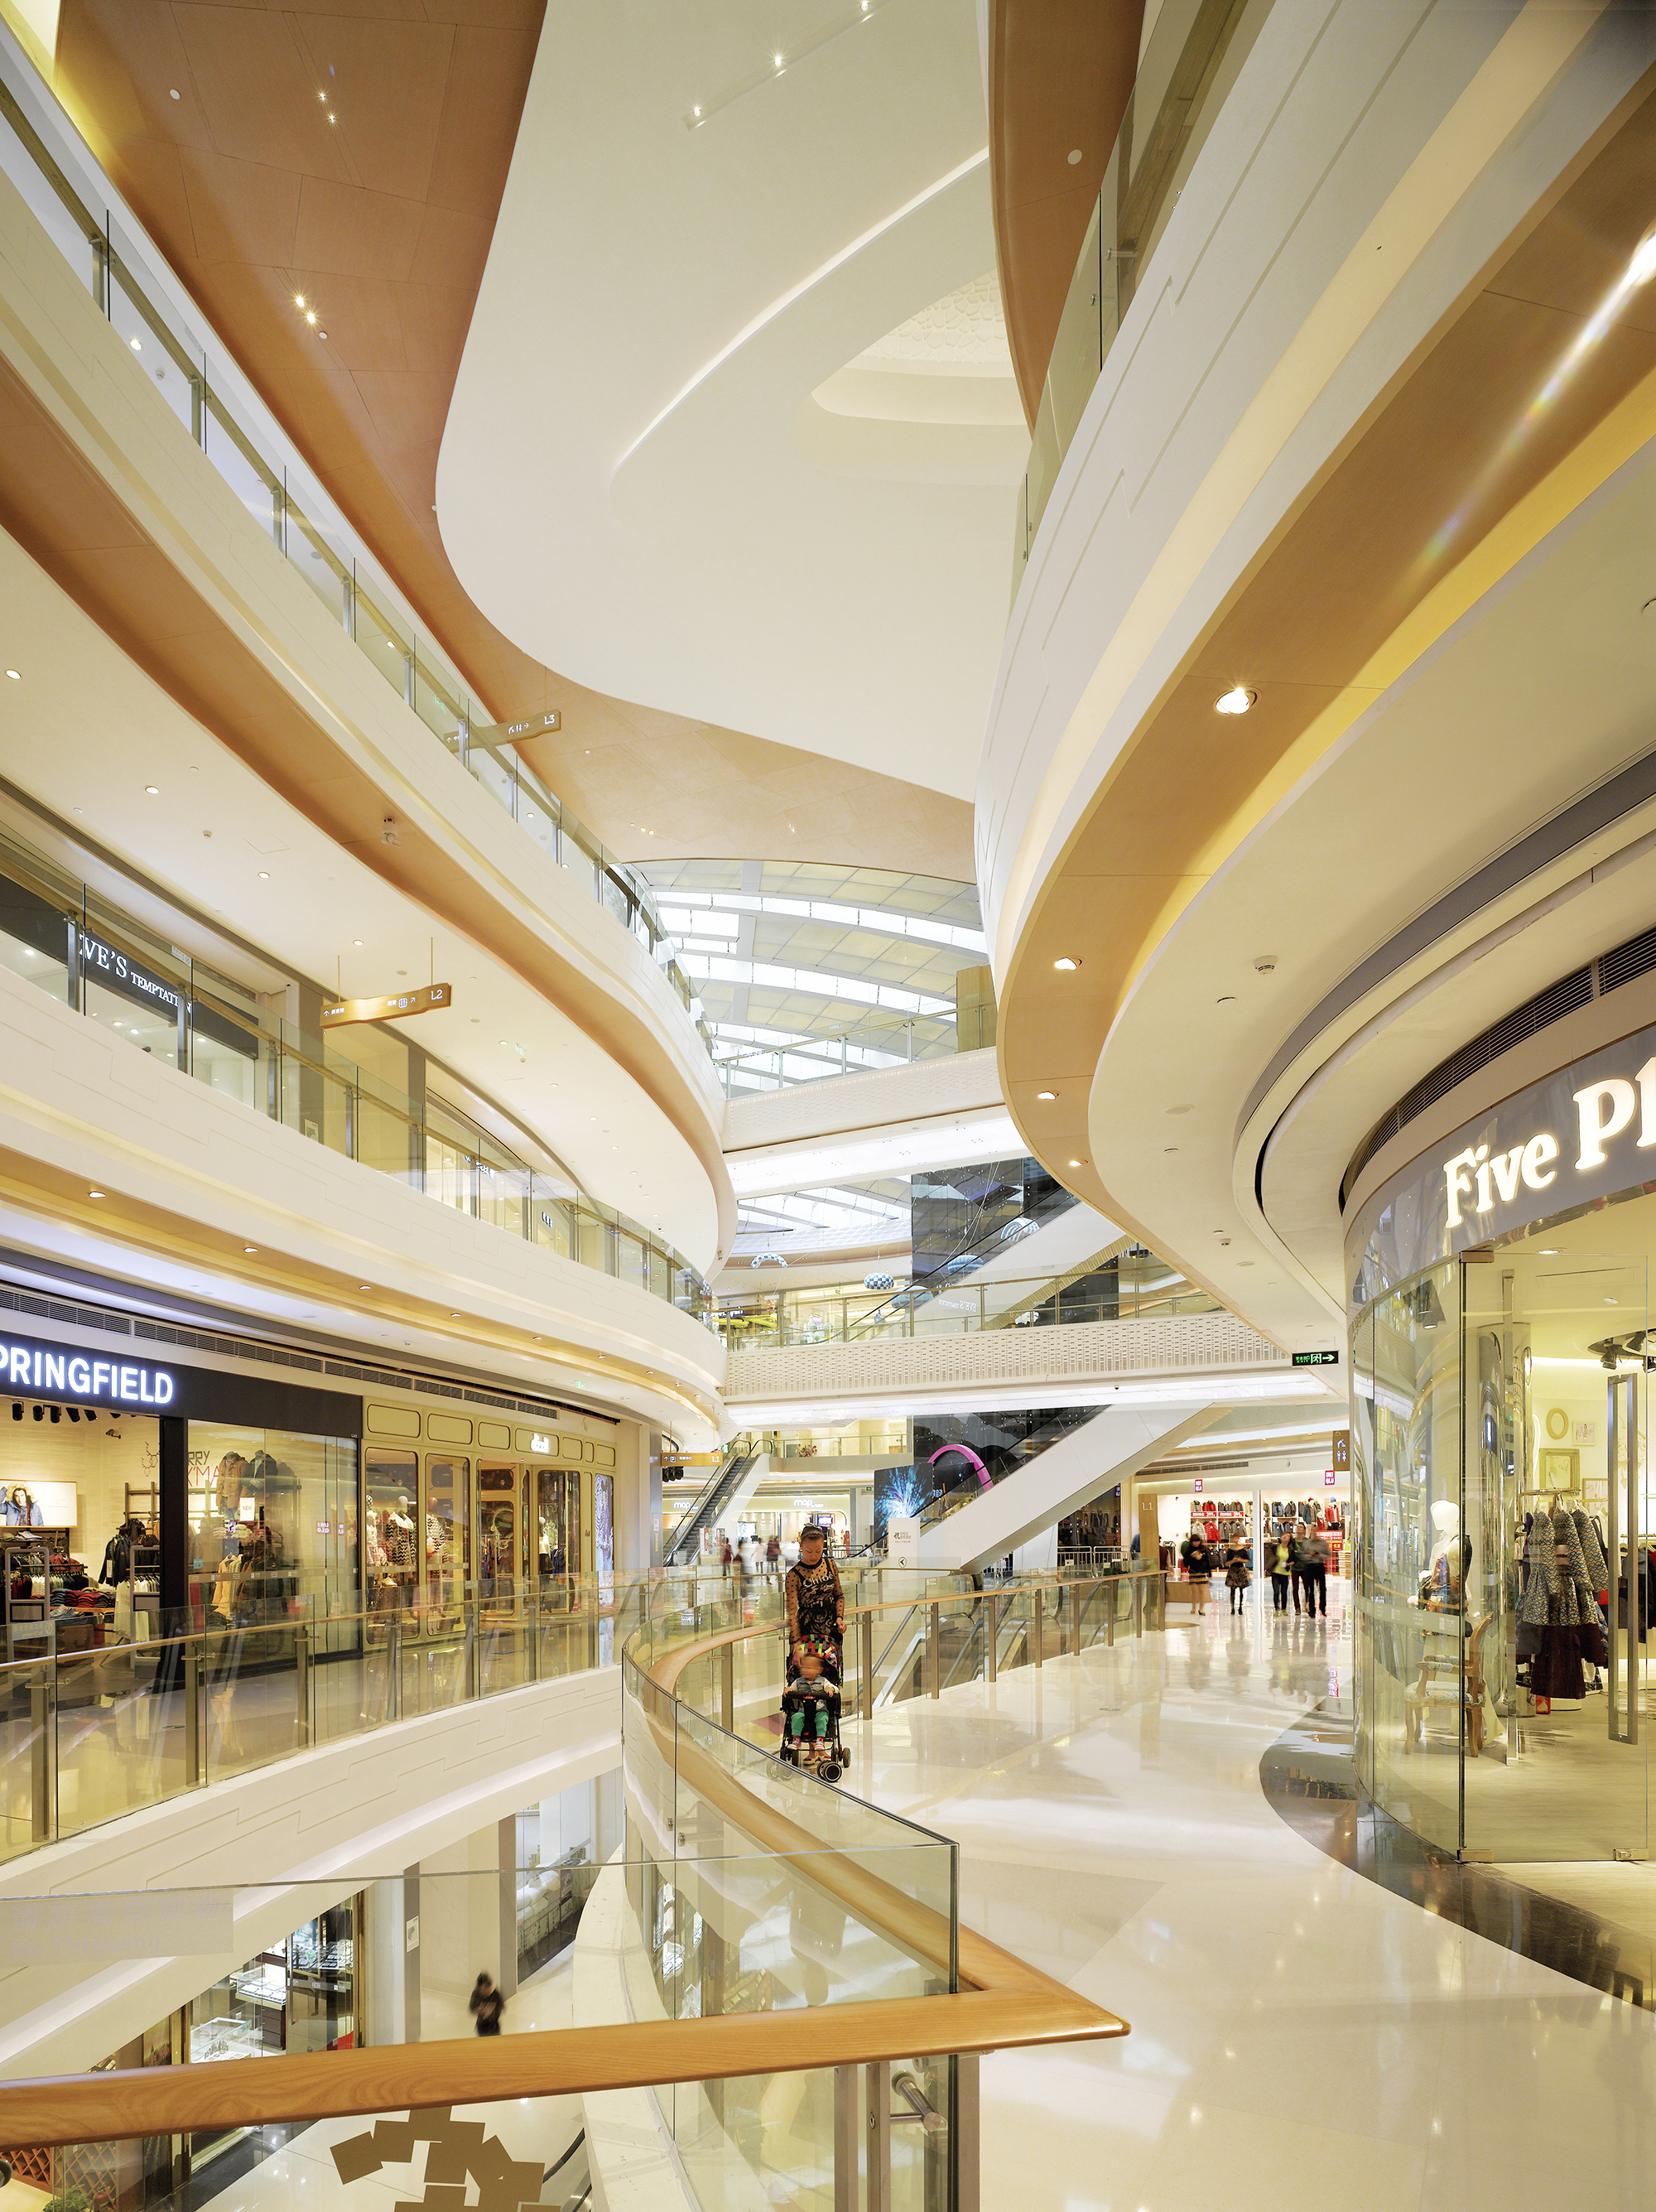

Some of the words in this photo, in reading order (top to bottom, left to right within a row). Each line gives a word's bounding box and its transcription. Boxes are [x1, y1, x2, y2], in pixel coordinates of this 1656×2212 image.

[544, 714, 556, 725] L3
[130, 971, 192, 1014] TEMPTATIN
[431, 989, 443, 1000] L2
[1443, 1133, 1559, 1229] Five
[1142, 1501, 1153, 1511] L1
[12, 1896, 221, 1930] 请勿高空抛物
[12, 1938, 44, 1959] No
[51, 1932, 161, 1955] Throwing
